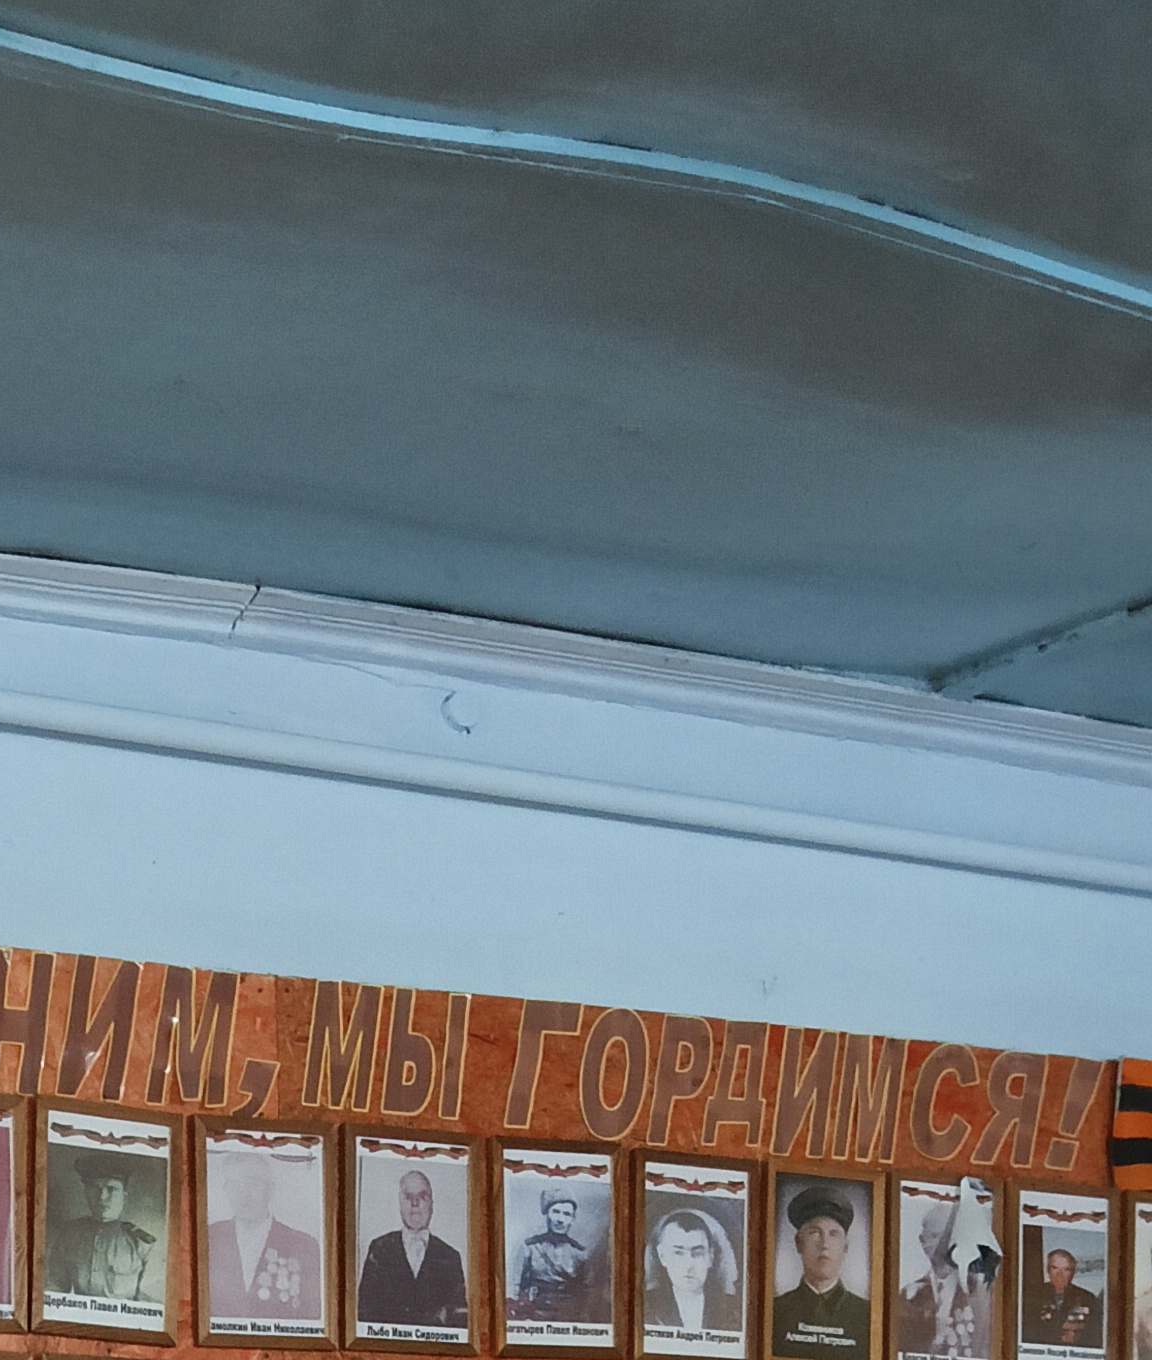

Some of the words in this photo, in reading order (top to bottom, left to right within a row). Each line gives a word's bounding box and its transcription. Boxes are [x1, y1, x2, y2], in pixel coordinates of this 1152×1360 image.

[301, 977, 471, 1121] МЫ
[504, 997, 1108, 1171] ГОРДИМСЯ!
[90, 1299, 118, 1313] Павел
[120, 1303, 163, 1318] Иванович
[250, 1321, 272, 1332] Иван
[391, 1327, 413, 1338] Иван
[415, 1329, 460, 1341] Сидорович
